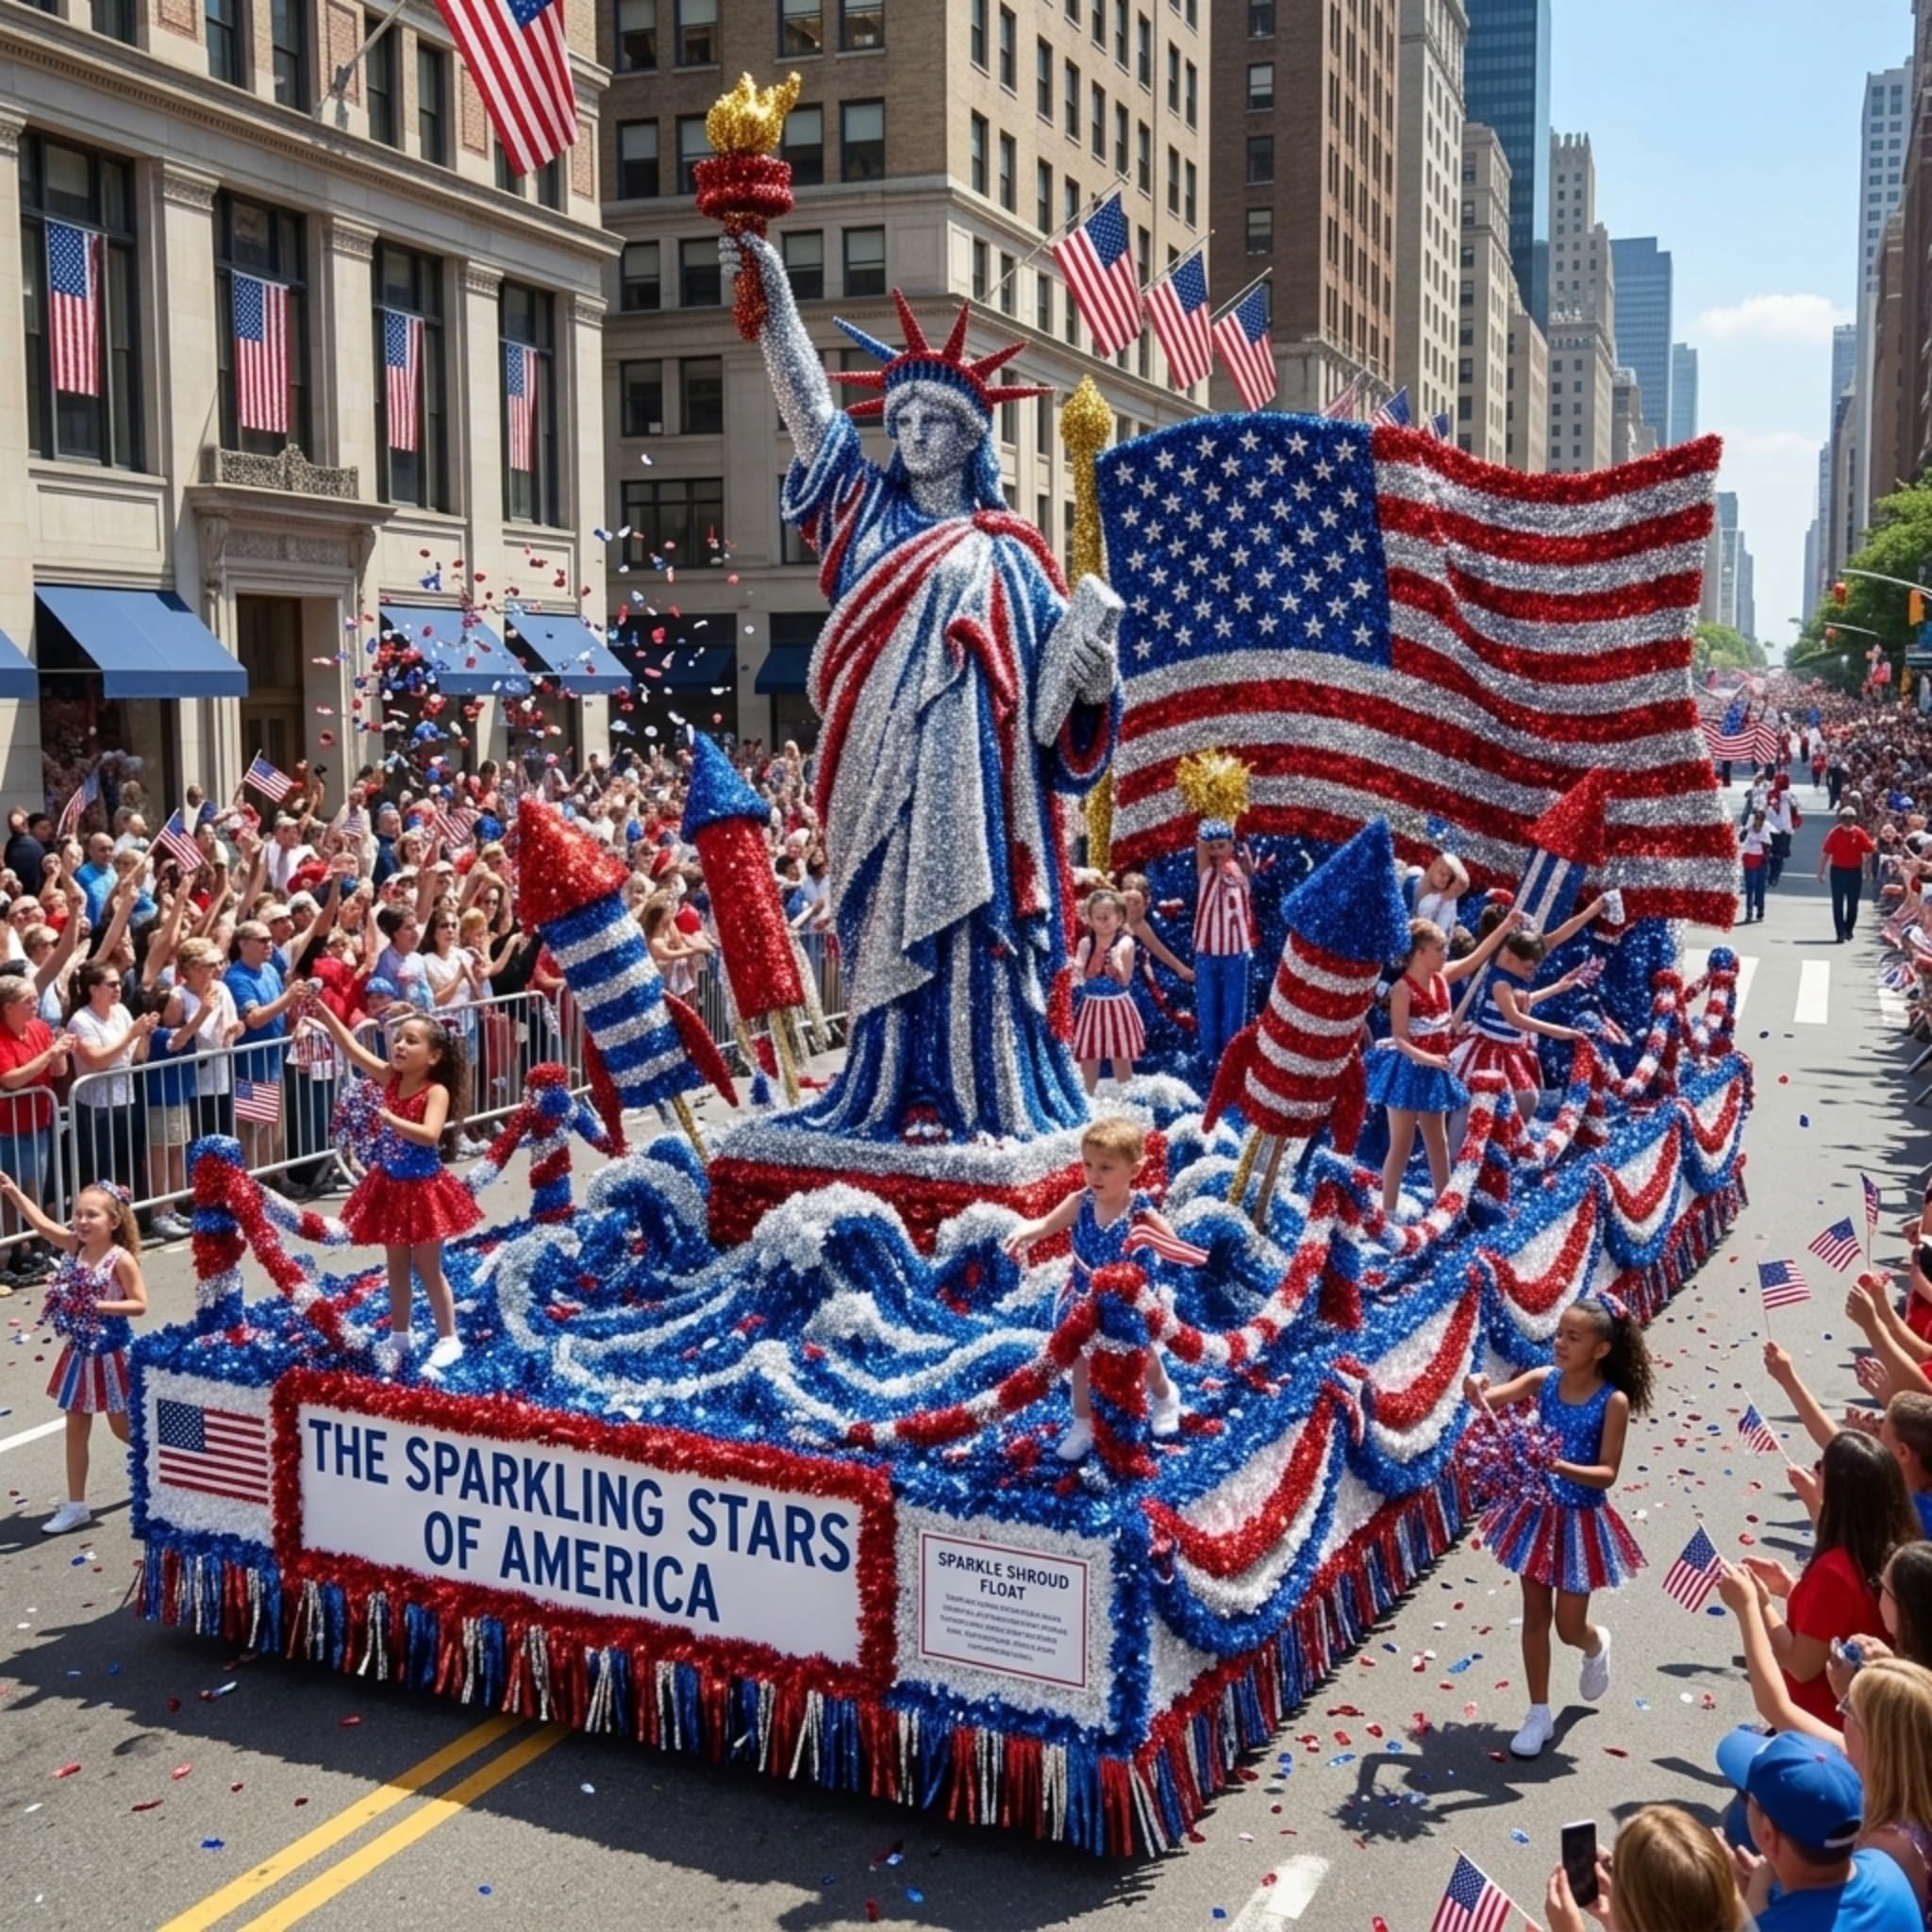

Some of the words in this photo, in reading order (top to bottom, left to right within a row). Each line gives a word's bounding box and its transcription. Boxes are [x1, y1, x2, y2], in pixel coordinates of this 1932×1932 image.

[308, 1419, 388, 1484] THE
[406, 1437, 664, 1537] SPARKLING
[687, 1488, 850, 1572] STARS
[424, 1510, 480, 1569] OF
[500, 1525, 720, 1622] AMERICA
[938, 1552, 1002, 1576] SPARKLE
[1007, 1565, 1069, 1590] SHROUD
[980, 1579, 1026, 1600] FLOAT
